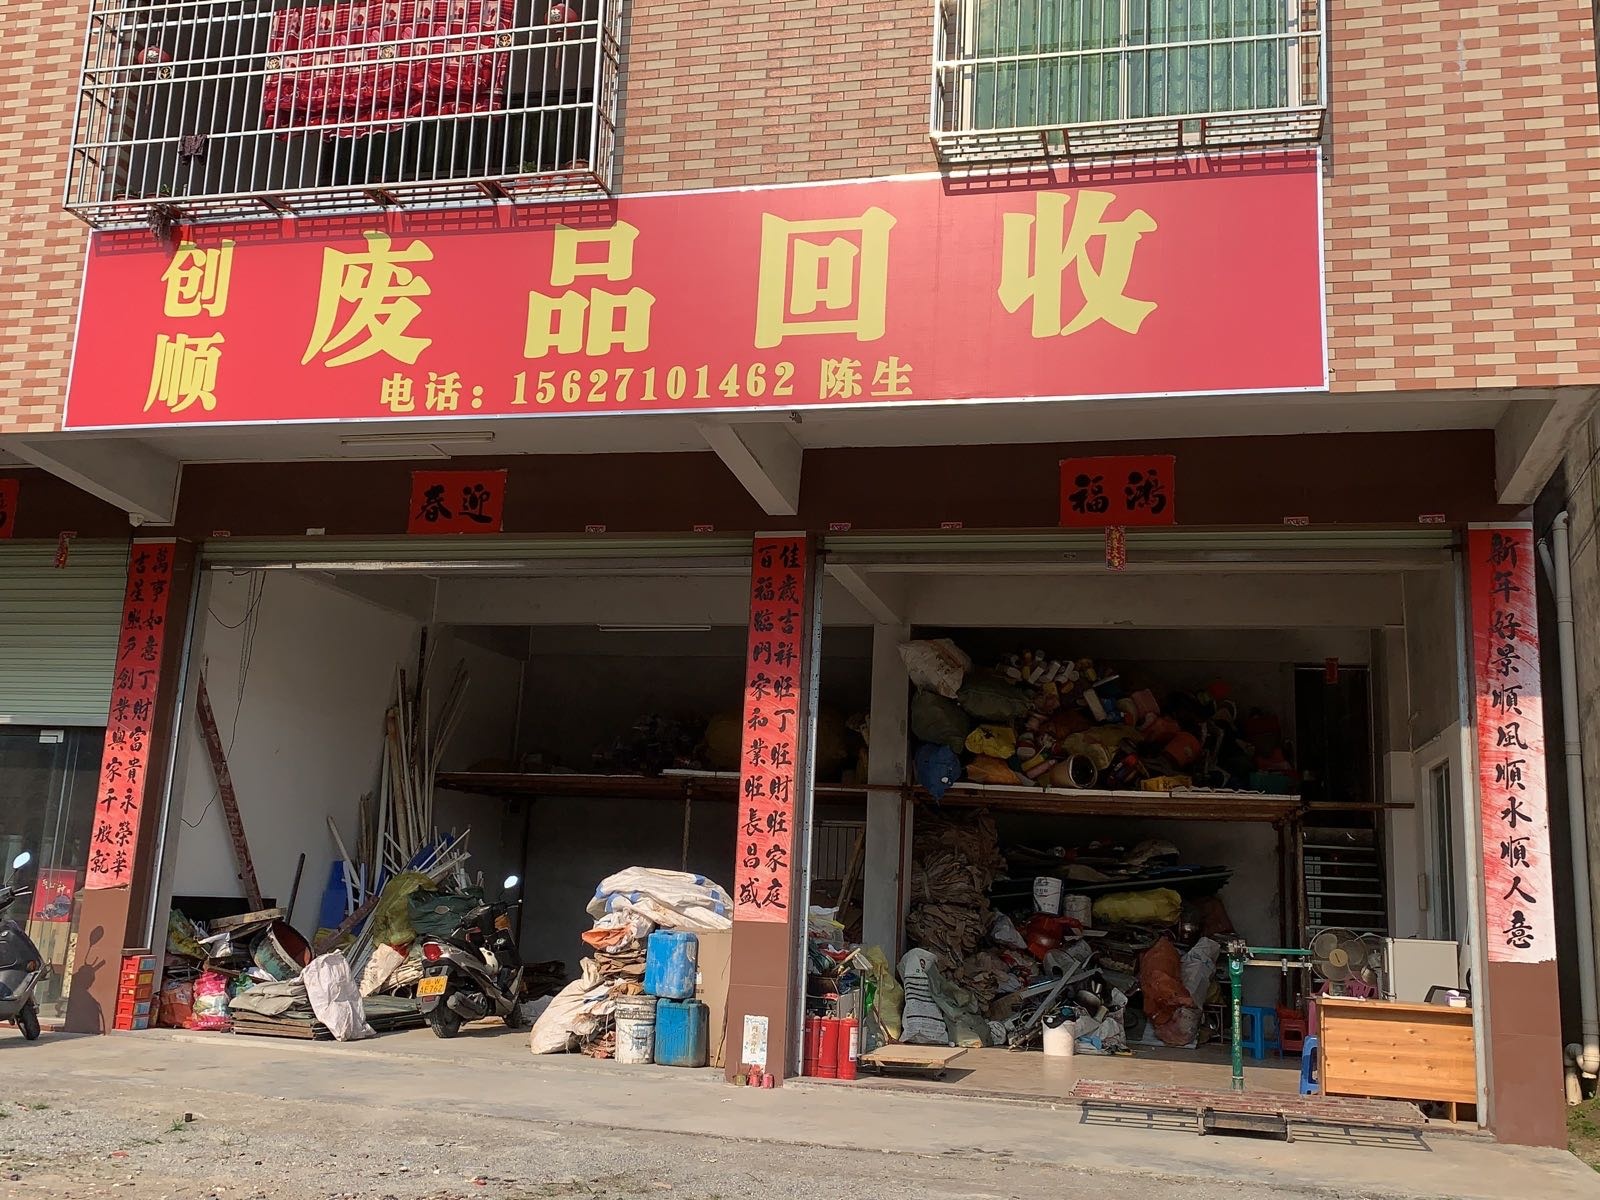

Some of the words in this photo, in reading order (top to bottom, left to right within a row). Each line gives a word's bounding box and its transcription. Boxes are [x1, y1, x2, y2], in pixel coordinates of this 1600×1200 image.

[142, 239, 235, 412] 创顺
[301, 190, 1158, 368] 废品回收
[510, 361, 795, 406] 15627101462
[820, 356, 913, 399] 陈生
